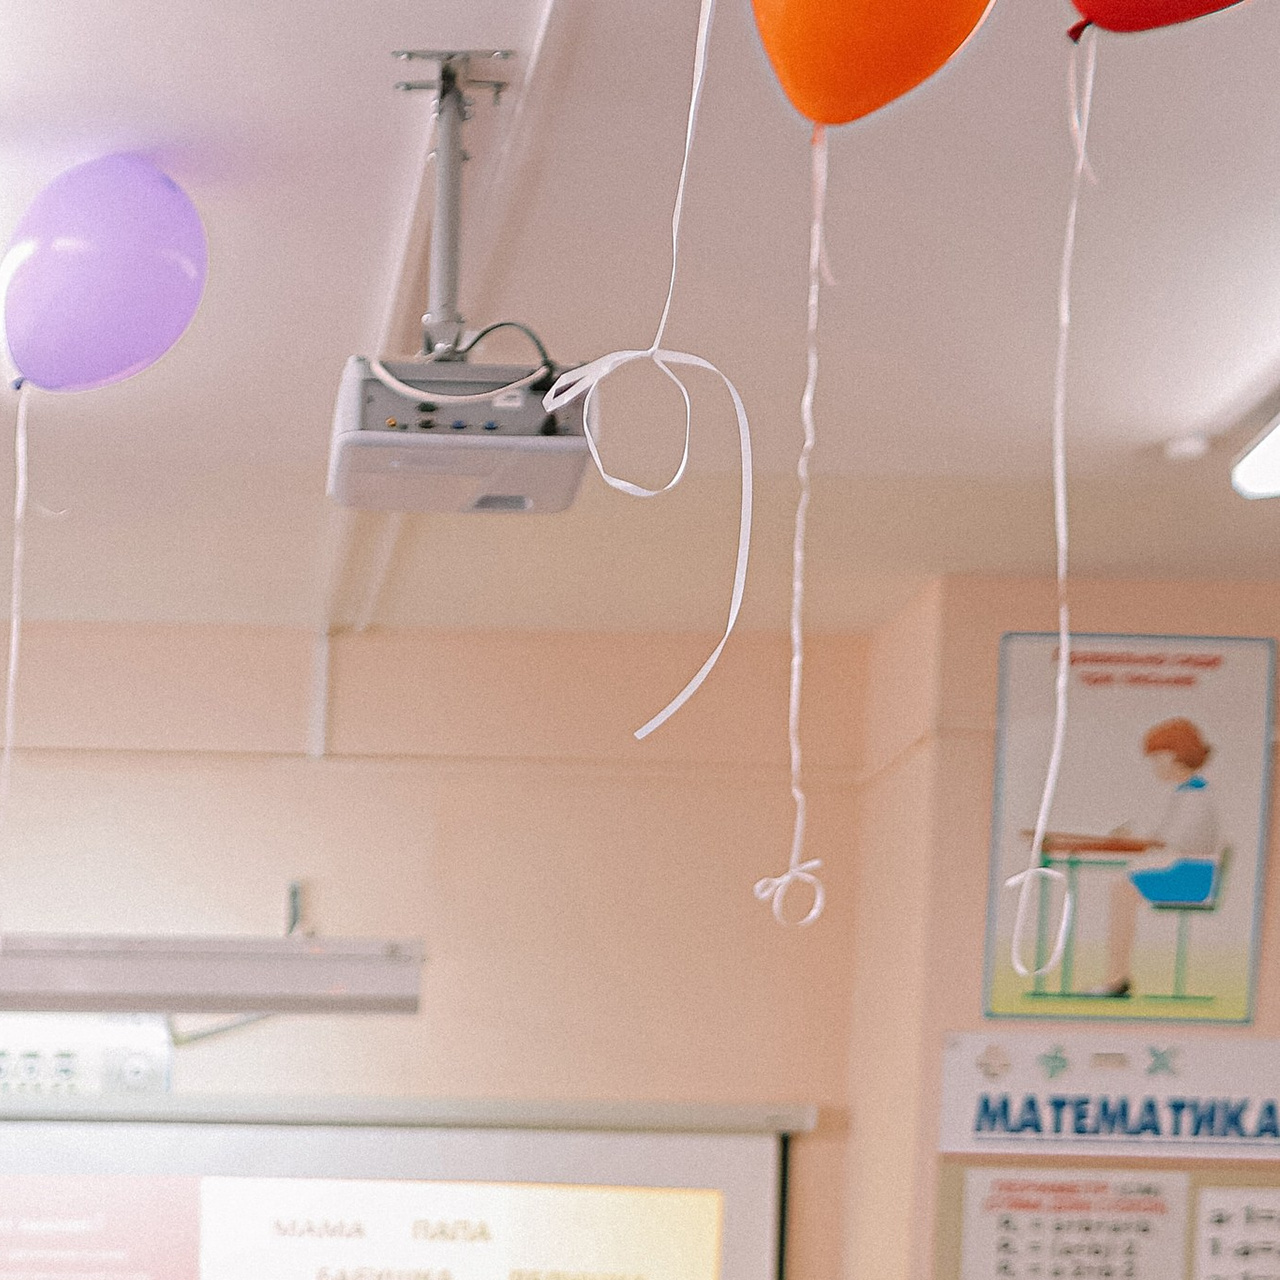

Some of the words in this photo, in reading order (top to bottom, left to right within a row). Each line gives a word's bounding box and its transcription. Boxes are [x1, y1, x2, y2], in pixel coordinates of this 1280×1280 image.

[974, 1092, 1280, 1138] МАТЕМАТИКА
[273, 1218, 366, 1239] МАМА
[410, 1218, 493, 1242] ПАПА
